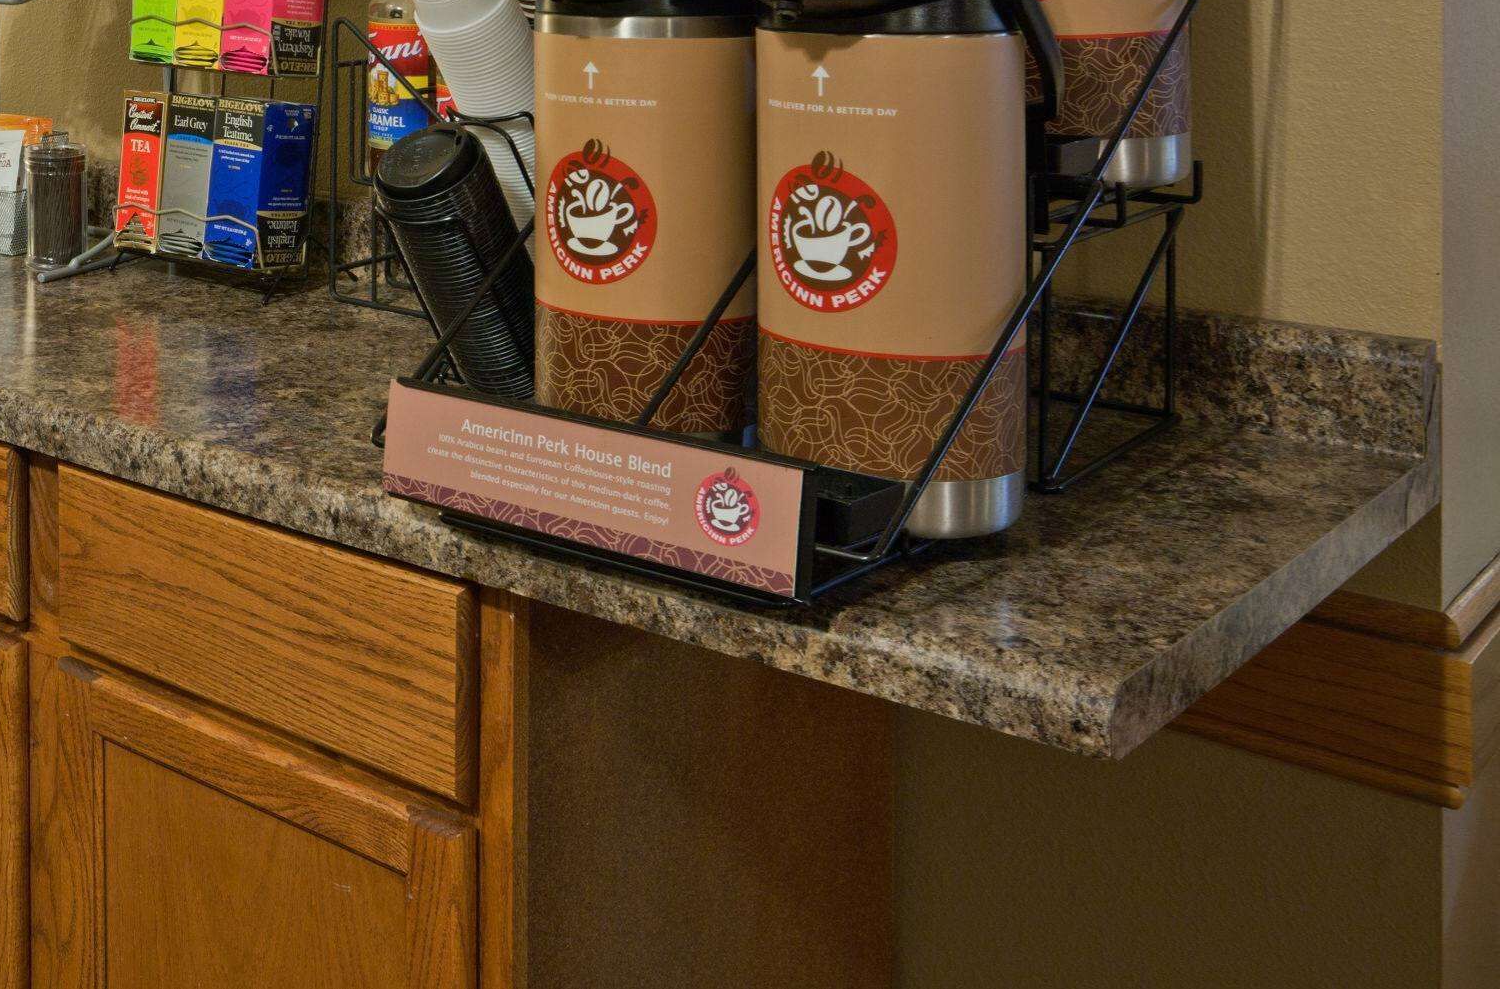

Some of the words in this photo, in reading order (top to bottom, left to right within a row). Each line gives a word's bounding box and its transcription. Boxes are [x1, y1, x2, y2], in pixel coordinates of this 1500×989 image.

[579, 96, 594, 104] FOR
[596, 97, 602, 105] A
[605, 98, 637, 107] BETTER
[640, 99, 657, 107] DAY
[783, 100, 805, 111] LEVER
[807, 103, 824, 113] FOR
[827, 105, 834, 114] A
[836, 105, 874, 116] BETTER
[877, 107, 898, 117] DAY
[174, 114, 188, 127] Earl
[189, 117, 208, 132] Grey
[225, 113, 252, 129] English
[131, 139, 150, 153] TEA
[547, 180, 593, 281] AMERICINN
[600, 242, 648, 281] PERK
[771, 196, 823, 308] AMERICINN
[831, 266, 887, 308] PERK
[461, 418, 533, 448] AmericInn
[537, 434, 569, 455] Perk
[575, 442, 622, 467] House
[628, 454, 671, 478] Blend
[427, 445, 449, 458] create
[451, 450, 463, 461] the
[465, 454, 502, 470] distinctive
[504, 463, 559, 484] characteristics
[561, 477, 570, 486] of
[571, 479, 586, 490] this
[588, 484, 640, 502] medium-dark
[438, 433, 455, 444] 100%
[457, 438, 484, 452] Arabica
[486, 444, 507, 457] beans
[510, 451, 524, 461] and
[526, 454, 562, 470] European
[564, 461, 635, 486] Coffeehouse-style
[637, 479, 671, 496] roasting
[470, 470, 500, 485] blended
[501, 479, 540, 495] especially
[541, 487, 552, 497] for
[554, 491, 568, 501] our
[729, 526, 755, 545] PERK
